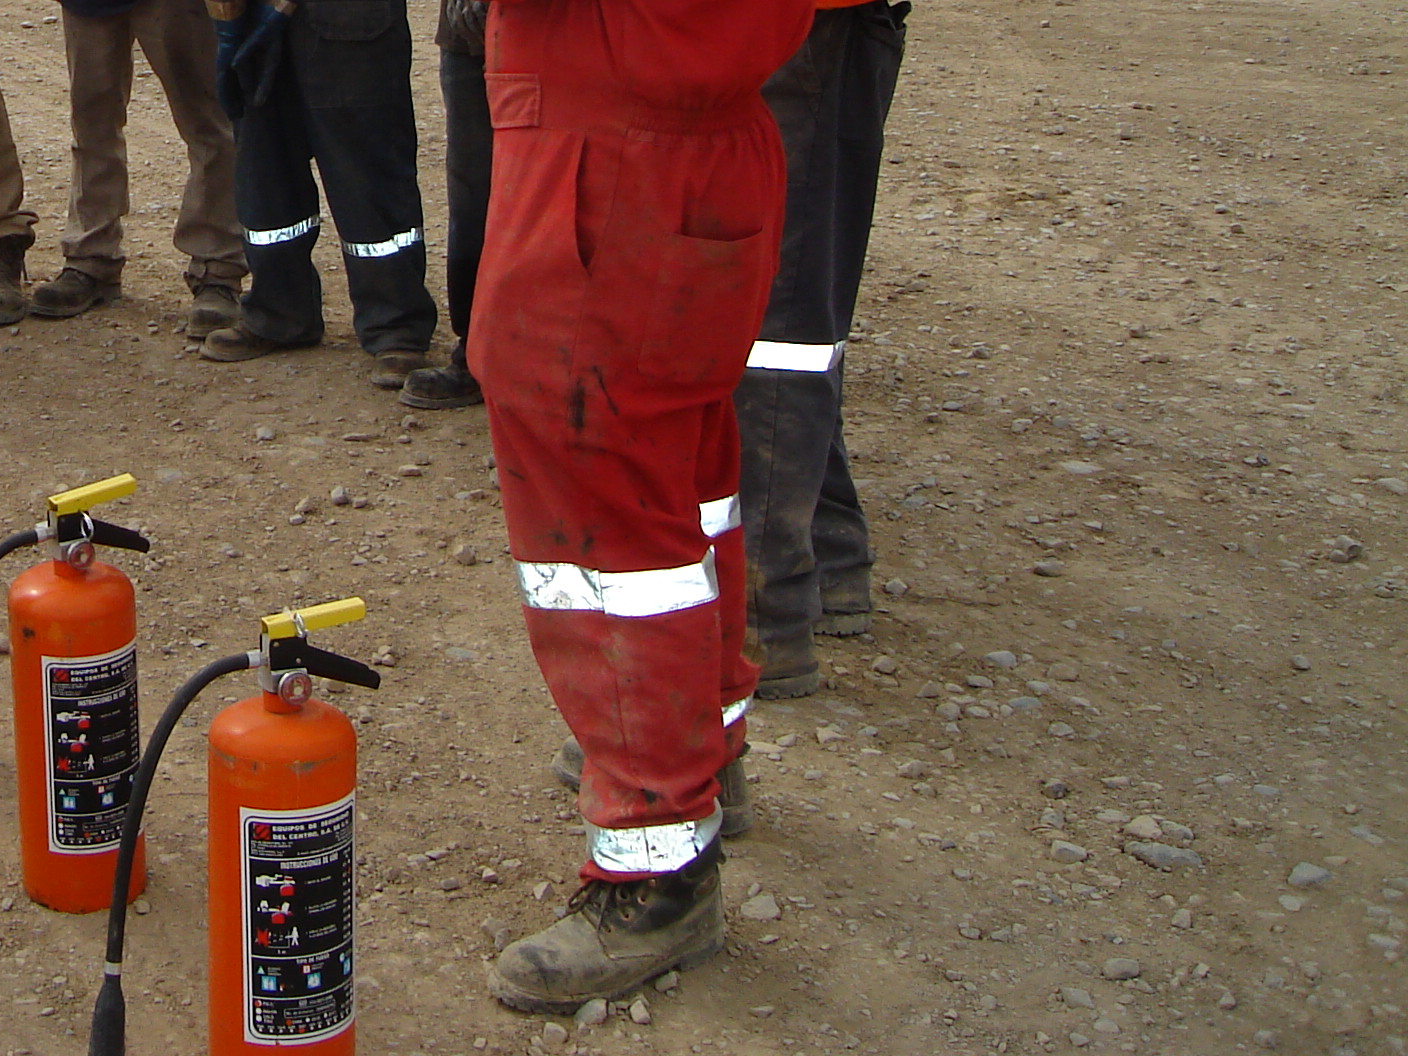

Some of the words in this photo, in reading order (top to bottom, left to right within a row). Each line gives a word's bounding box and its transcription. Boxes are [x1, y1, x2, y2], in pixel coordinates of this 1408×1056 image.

[272, 824, 305, 833] EQUIPOS
[307, 822, 317, 830] DE
[272, 833, 288, 841] DEL
